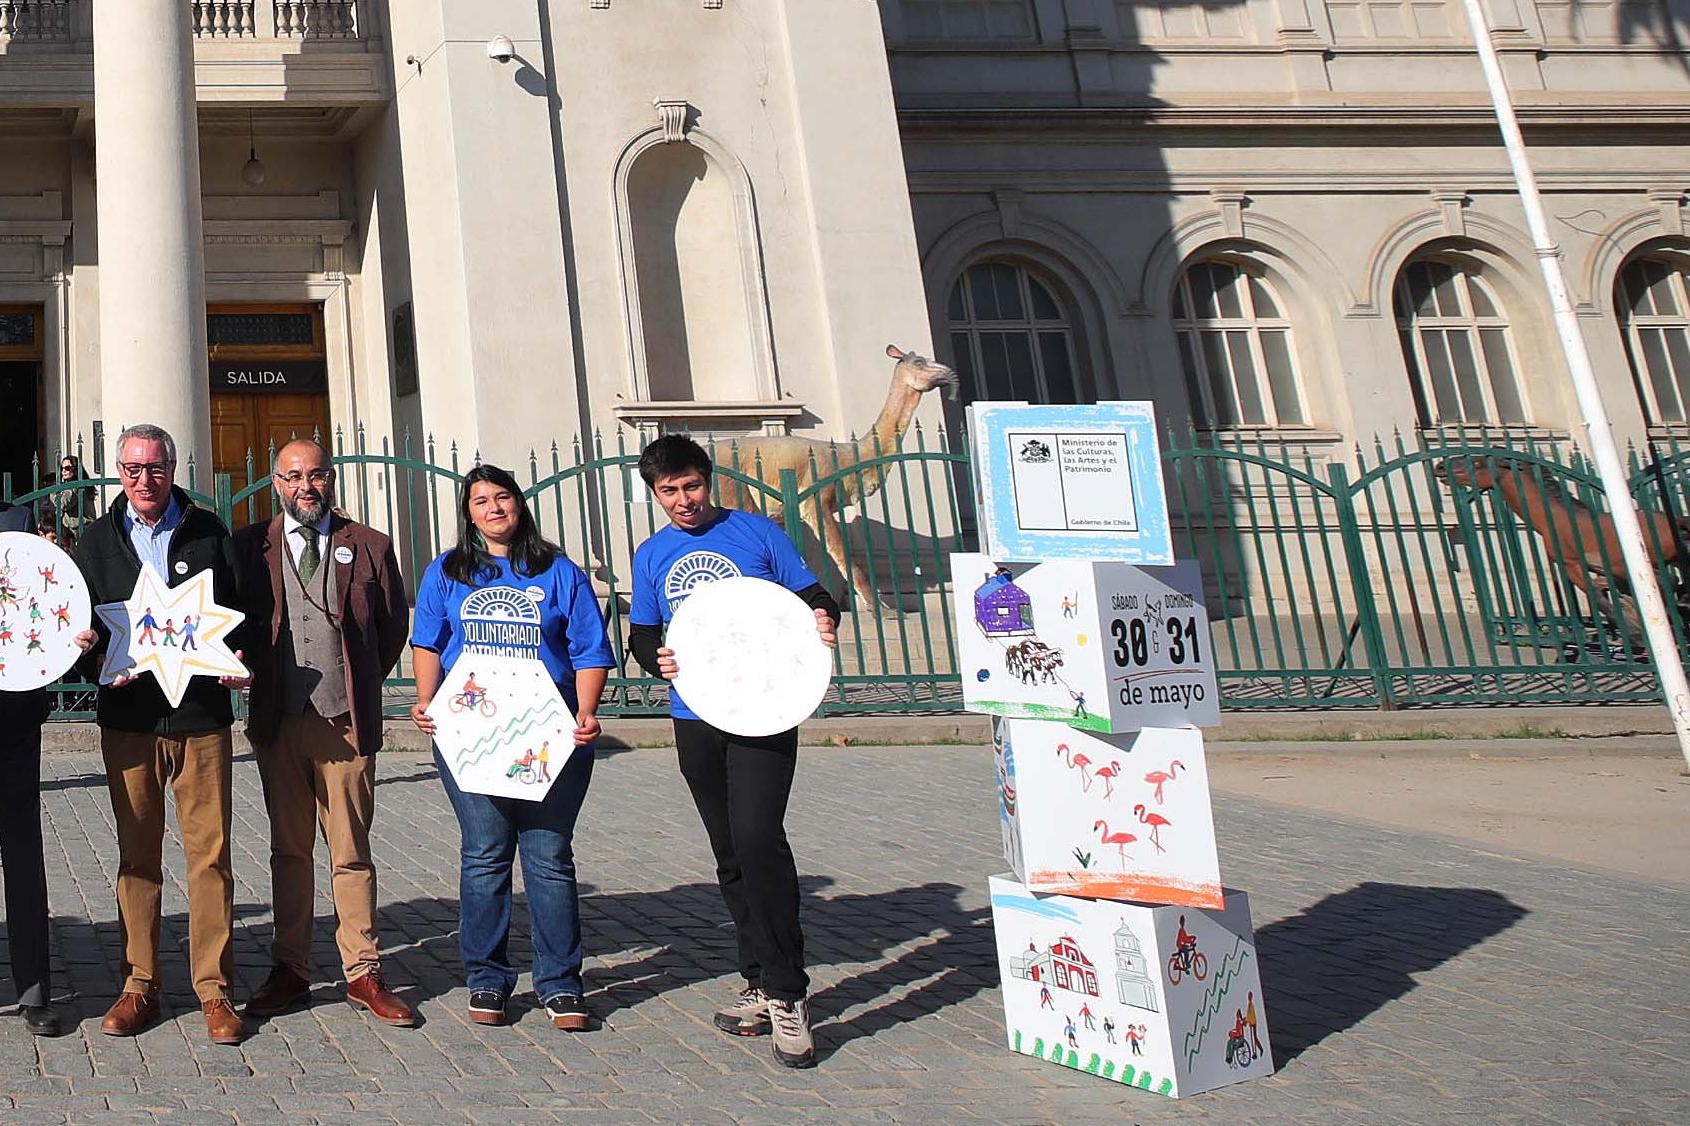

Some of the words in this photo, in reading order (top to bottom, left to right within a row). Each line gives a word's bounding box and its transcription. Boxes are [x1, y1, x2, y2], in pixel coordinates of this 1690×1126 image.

[227, 371, 287, 384] SALIDA
[1076, 448, 1114, 456] Culturas,
[1064, 465, 1112, 473] Patrimonio
[1111, 592, 1139, 610] SÁBADO
[1164, 593, 1194, 609] DOMINGO
[462, 621, 541, 647] VOLUNTARIADO
[1110, 618, 1149, 668] 30
[1166, 616, 1201, 665] 31
[1120, 679, 1143, 706] de
[1149, 682, 1205, 710] mayo
